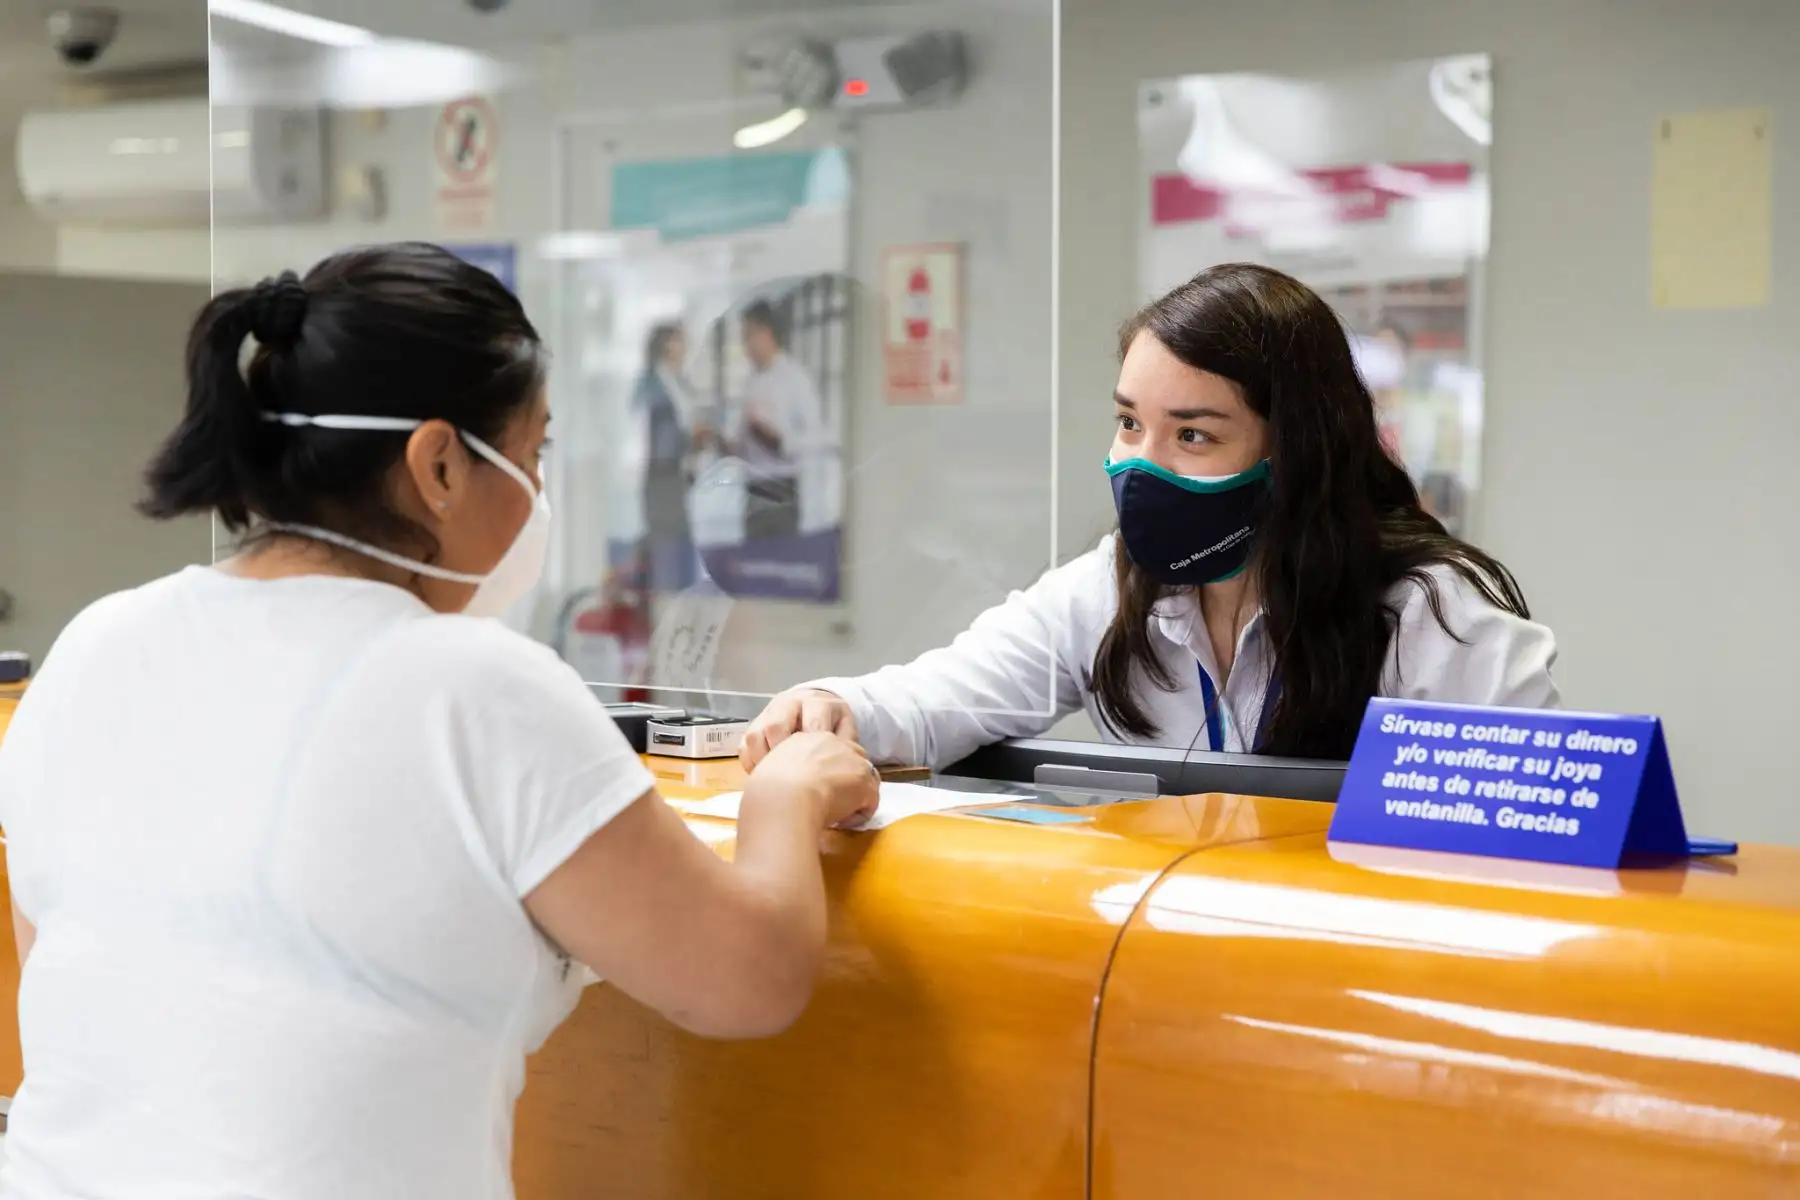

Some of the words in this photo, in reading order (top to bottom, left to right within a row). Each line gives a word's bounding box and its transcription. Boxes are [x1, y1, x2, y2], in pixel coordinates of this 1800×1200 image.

[1170, 558, 1191, 570] Caja
[1191, 526, 1250, 561] Metropolitana
[1379, 713, 1457, 739] Sírvase
[1460, 723, 1531, 745] contar
[1531, 730, 1562, 749] su
[1566, 729, 1638, 756] dinero
[1392, 741, 1429, 766] y/o
[1432, 747, 1520, 773] verificar
[1522, 756, 1551, 776] su
[1550, 756, 1603, 784] joya
[1381, 770, 1439, 793] antes
[1443, 773, 1472, 796] de
[1473, 778, 1567, 806] retirarse
[1570, 786, 1600, 809] de
[1384, 798, 1490, 826] ventanilla.
[1495, 806, 1580, 836] Gracias
